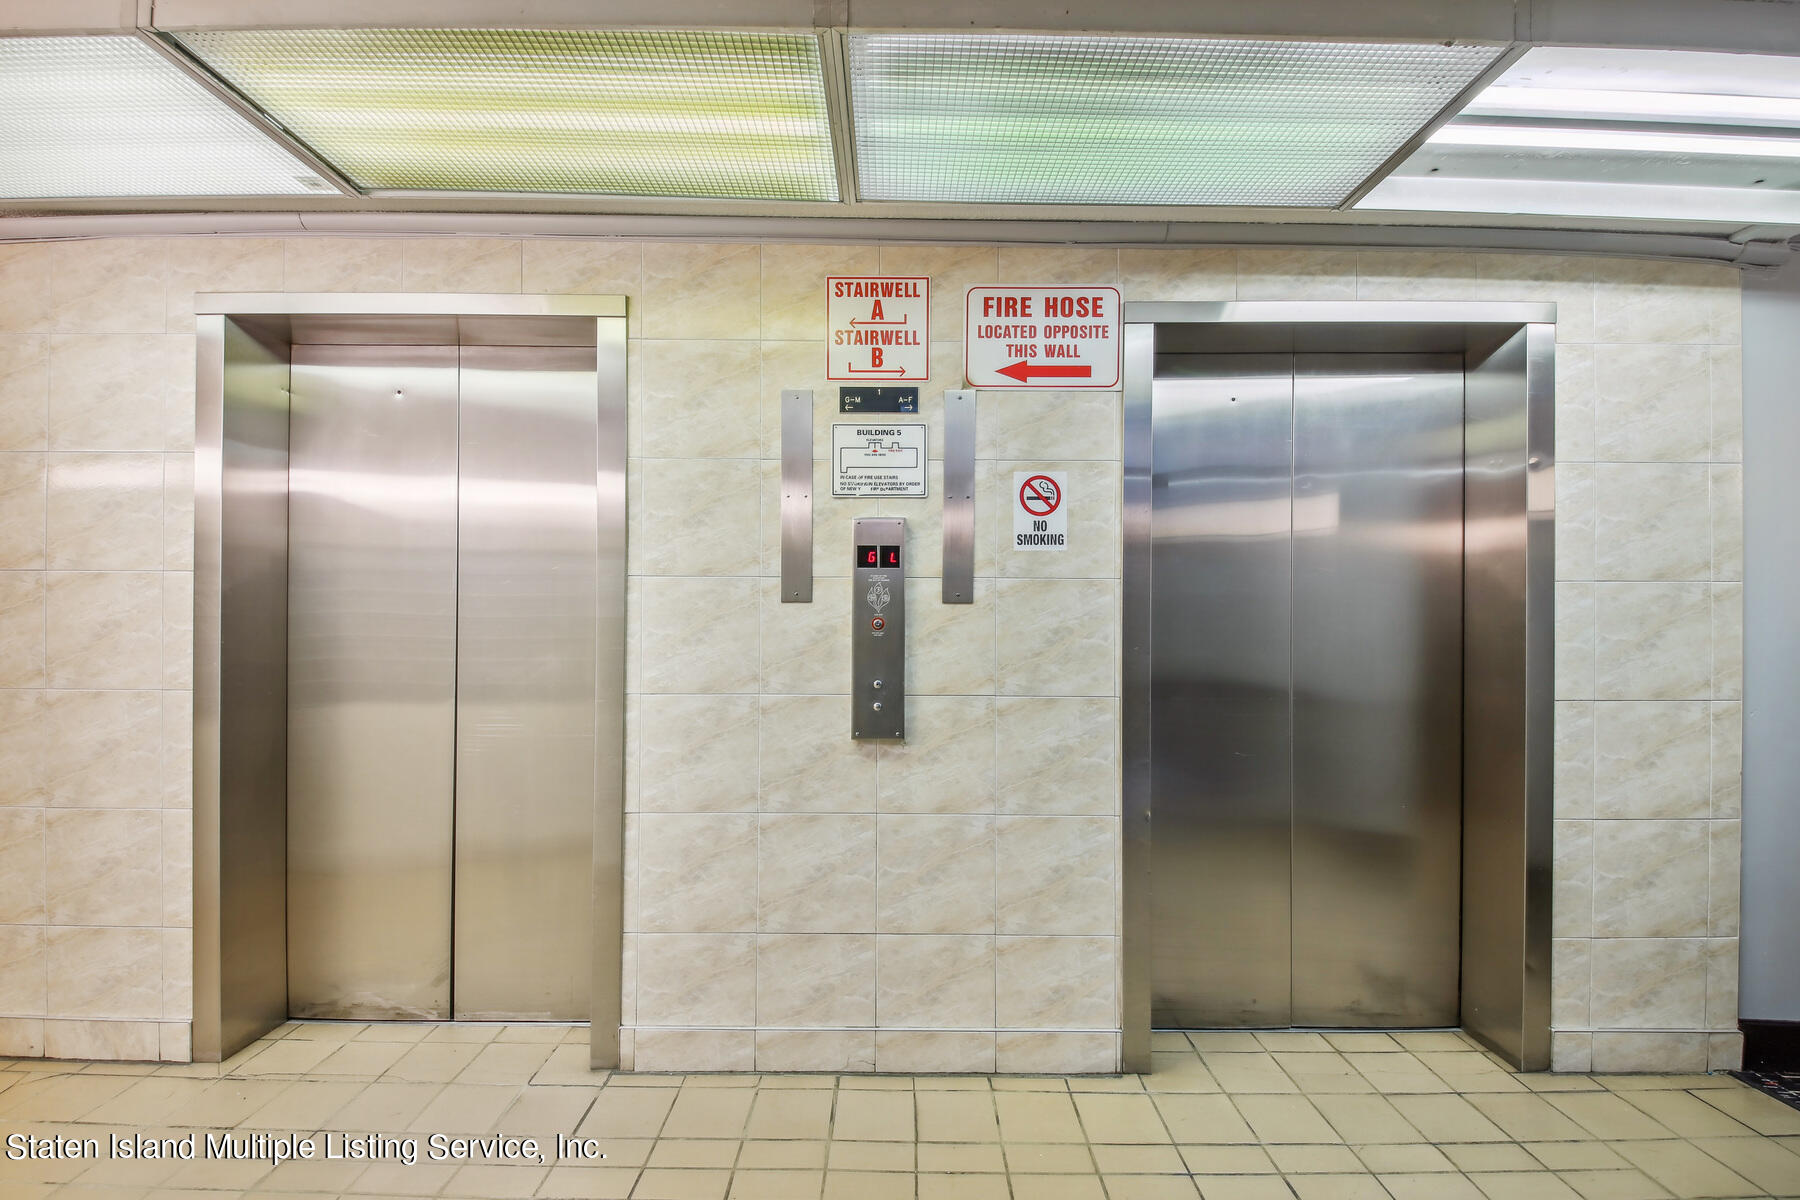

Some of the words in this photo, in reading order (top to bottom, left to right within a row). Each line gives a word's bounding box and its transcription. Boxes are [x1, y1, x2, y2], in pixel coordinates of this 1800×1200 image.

[835, 281, 921, 298] STAIRWELL
[871, 299, 885, 321] A
[983, 296, 1032, 318] FIRE
[1044, 296, 1104, 318] HOSE
[835, 329, 921, 346] STAIRWELL
[977, 324, 1037, 339] LOCATED
[1043, 324, 1109, 339] OPPOSITE
[871, 347, 884, 368] B
[1006, 343, 1038, 358] THIS
[1044, 343, 1081, 358] WALL
[1033, 520, 1048, 532] NO
[1017, 533, 1064, 546] SMOKING
[867, 551, 876, 563] G
[890, 551, 897, 563] L
